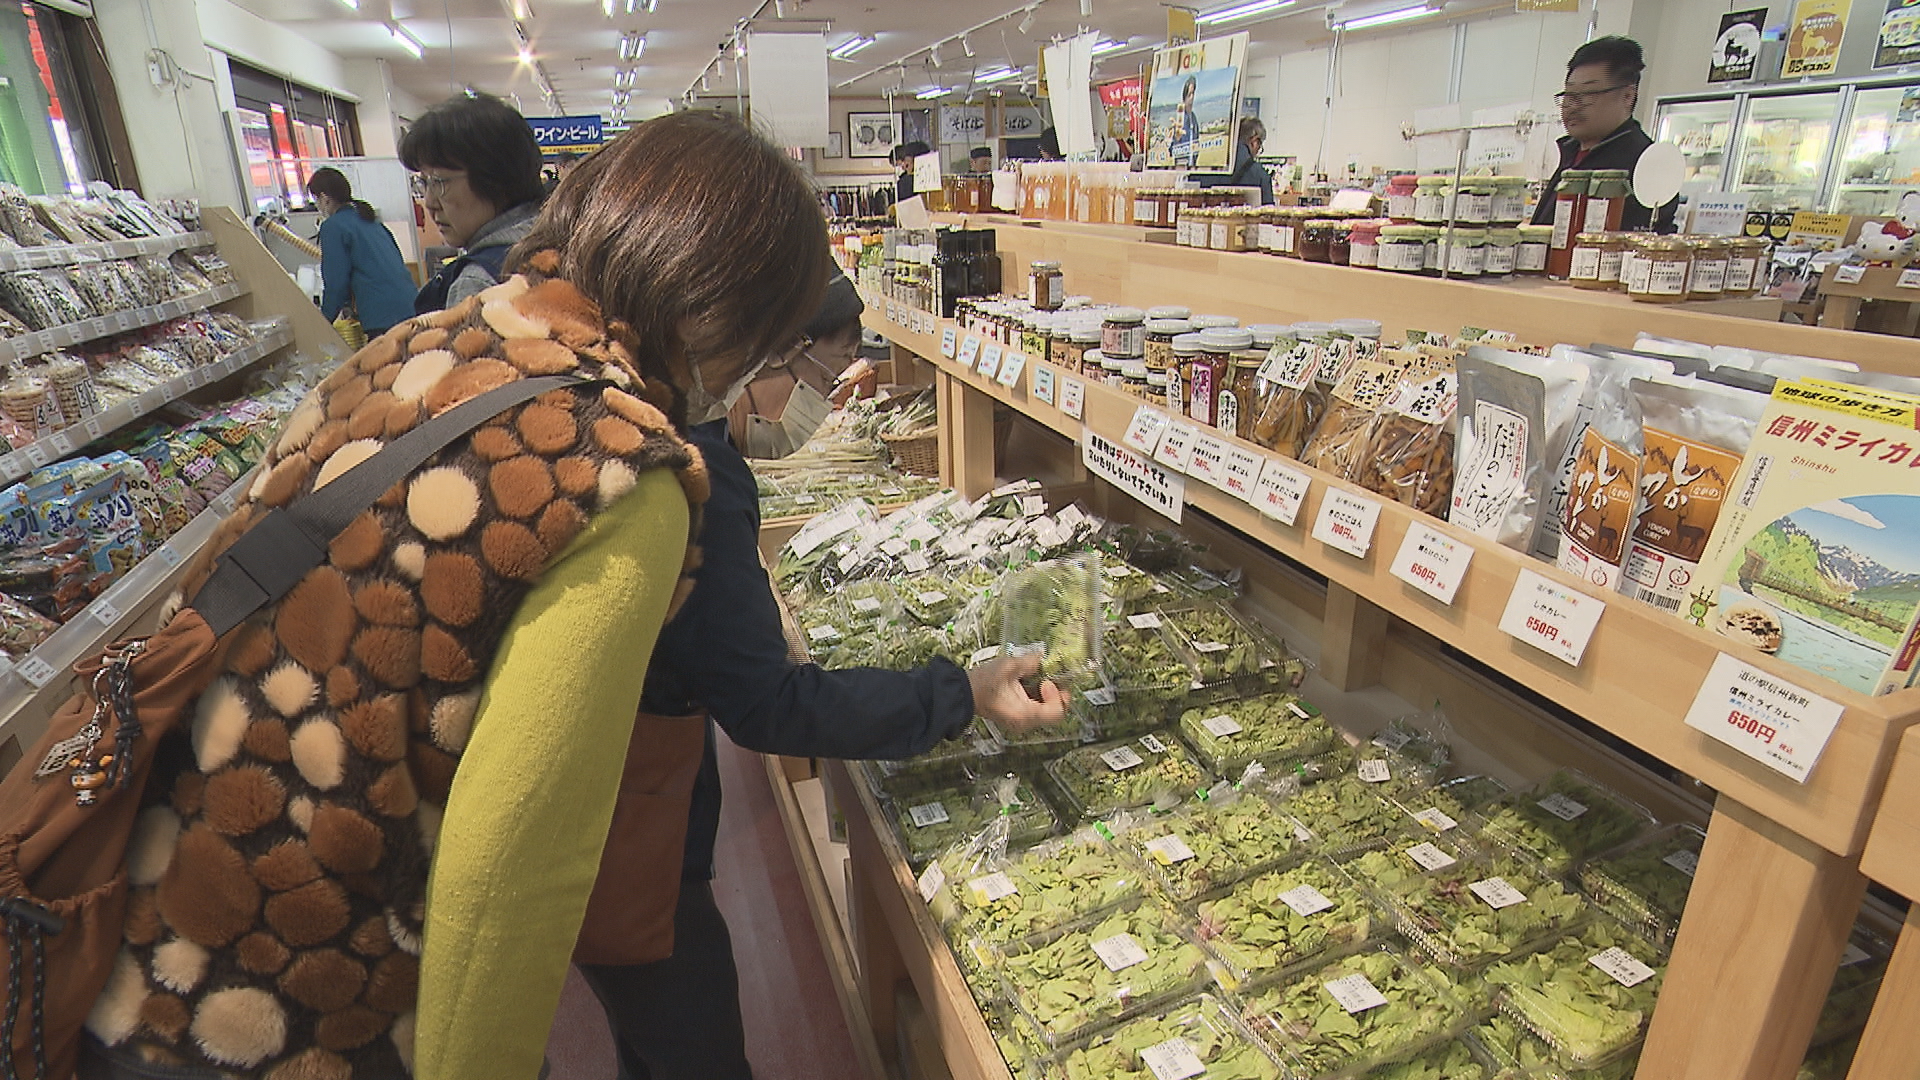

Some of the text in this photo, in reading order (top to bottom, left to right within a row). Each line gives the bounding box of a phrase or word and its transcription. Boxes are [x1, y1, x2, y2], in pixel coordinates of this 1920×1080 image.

[534, 125, 599, 141] ワイン・ビール
[1780, 386, 1909, 418] 地球の歩き方
[1790, 455, 1837, 475] Shinshu
[1693, 486, 1719, 498] ながの
[1411, 562, 1437, 585] 650円
[1533, 600, 1567, 619] しかカレー
[1526, 616, 1559, 641] 650円
[1738, 669, 1810, 709] 道の駅信州新町
[1729, 686, 1801, 723] 信州ミライカレー
[1727, 709, 1777, 745] 650円
